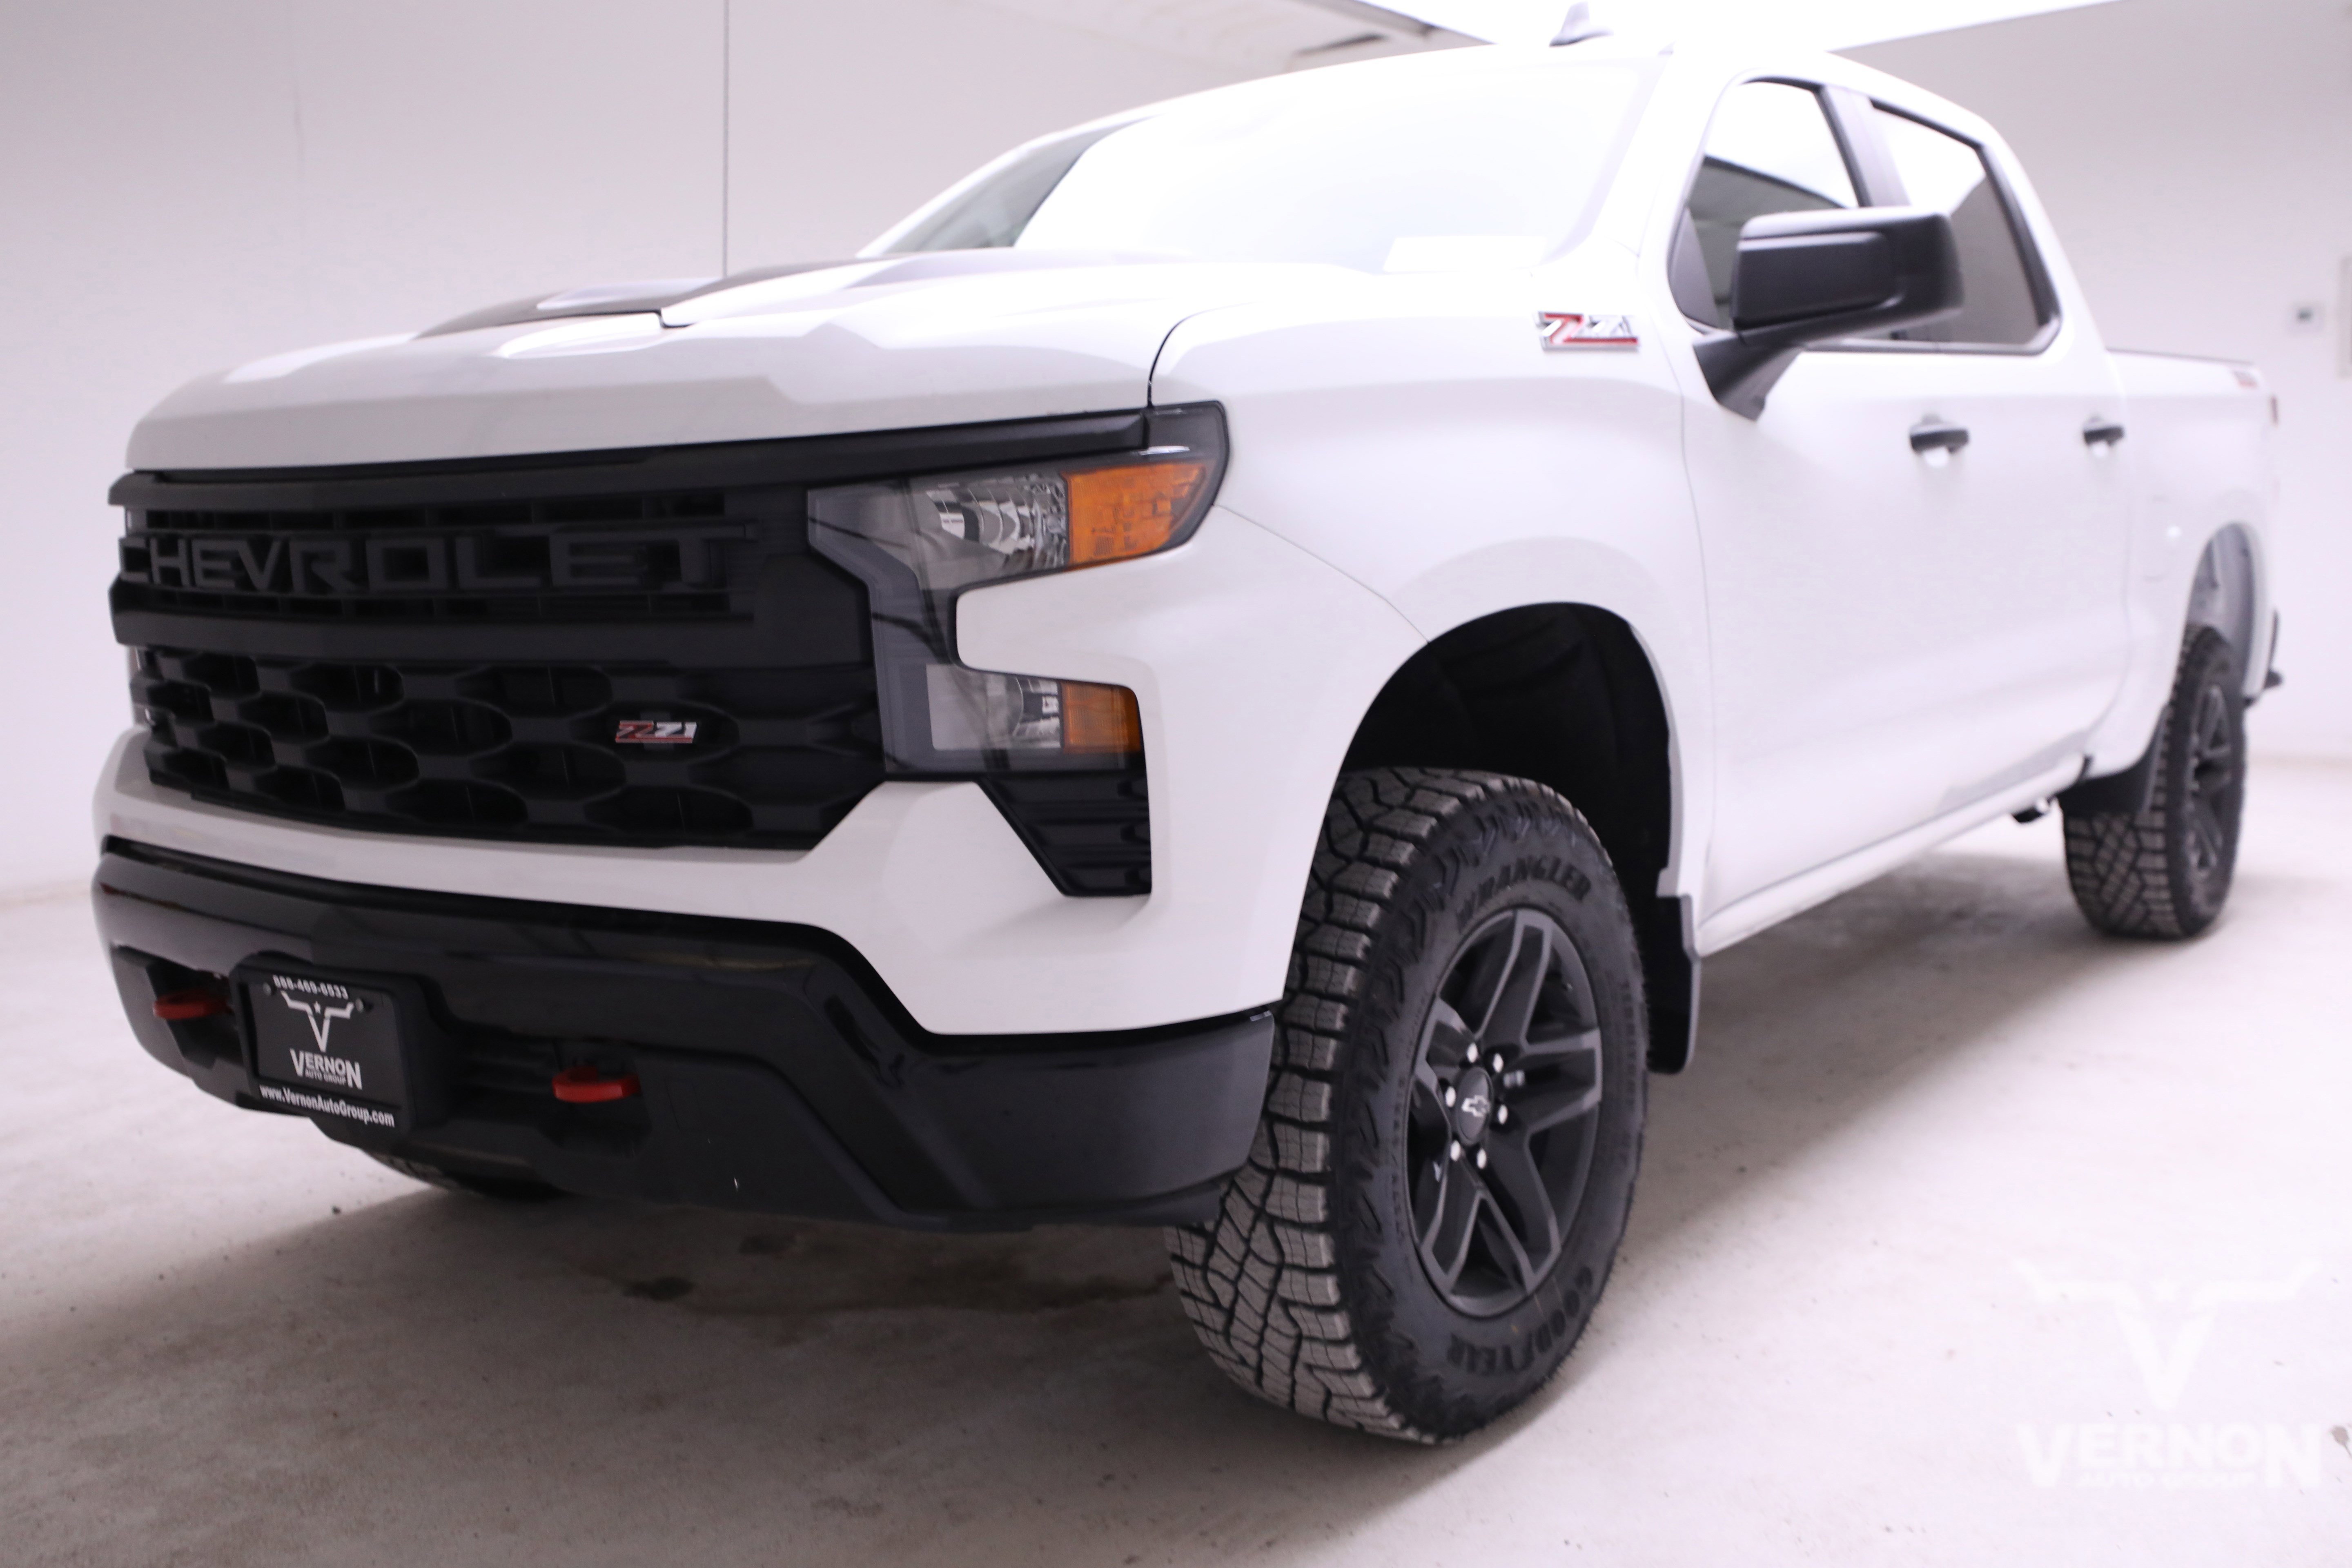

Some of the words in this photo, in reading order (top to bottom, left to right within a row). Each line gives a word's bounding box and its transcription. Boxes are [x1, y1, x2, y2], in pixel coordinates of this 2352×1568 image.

[120, 521, 758, 592] CHEVROLET
[615, 720, 697, 744] Z71
[1457, 854, 1592, 935] WRANGLER
[290, 1048, 362, 1090] VERNON
[305, 1069, 322, 1080] AUTO
[259, 1085, 395, 1128] www.VernonAutoGroup.com
